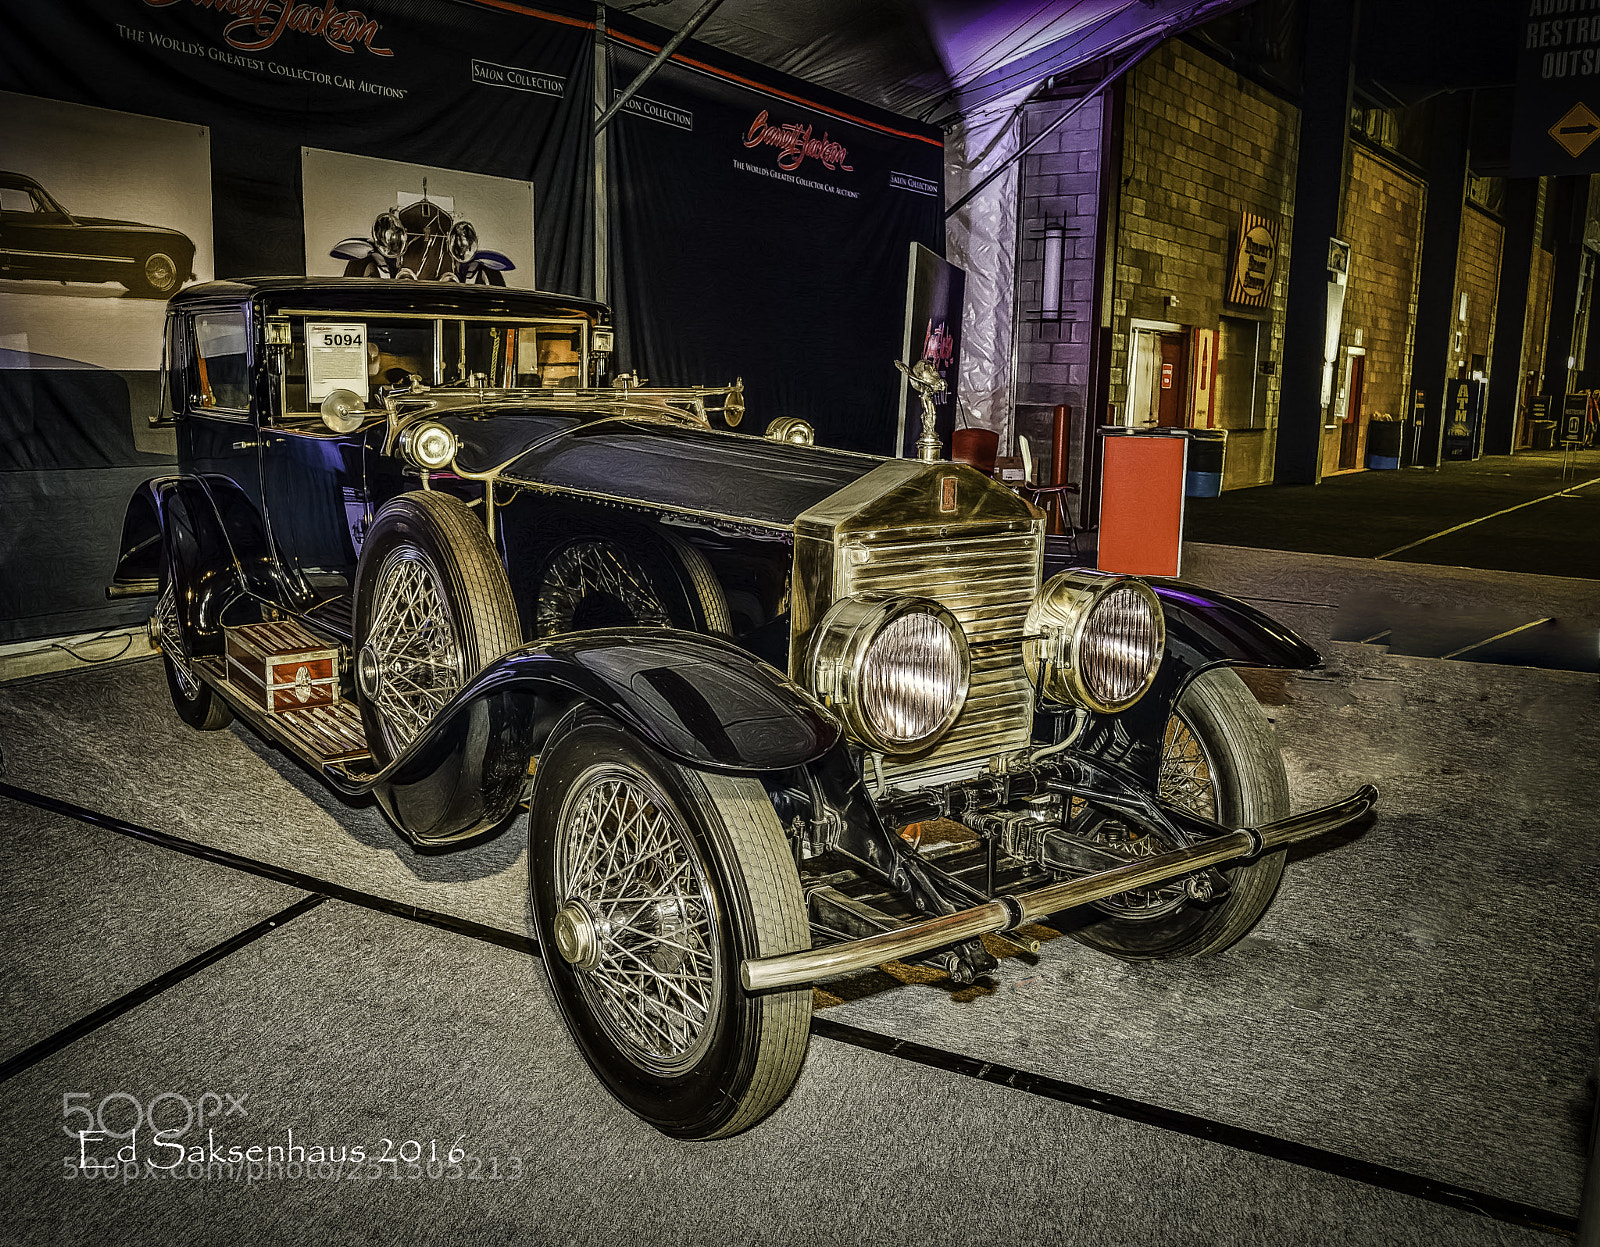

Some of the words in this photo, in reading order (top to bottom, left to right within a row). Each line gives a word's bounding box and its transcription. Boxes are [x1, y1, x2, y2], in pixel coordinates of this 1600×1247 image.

[115, 23, 145, 42] THE
[149, 31, 205, 57] WORLD'S
[208, 47, 265, 71] GREATEST
[267, 61, 332, 85] COLLECTOR
[334, 75, 356, 90] CAR
[474, 64, 504, 82] SALON
[507, 71, 564, 92] COLLECTION
[643, 101, 691, 126] COLLECTION
[733, 159, 745, 170] THE
[745, 161, 770, 177] WORLD'S
[770, 169, 795, 183] GREATEST
[795, 176, 824, 191] COLLECTOR
[824, 183, 835, 193] CAR
[890, 175, 907, 186] SALON
[907, 178, 938, 193] COLLECTION
[323, 334, 363, 346] 5094
[1454, 384, 1470, 423] ATM
